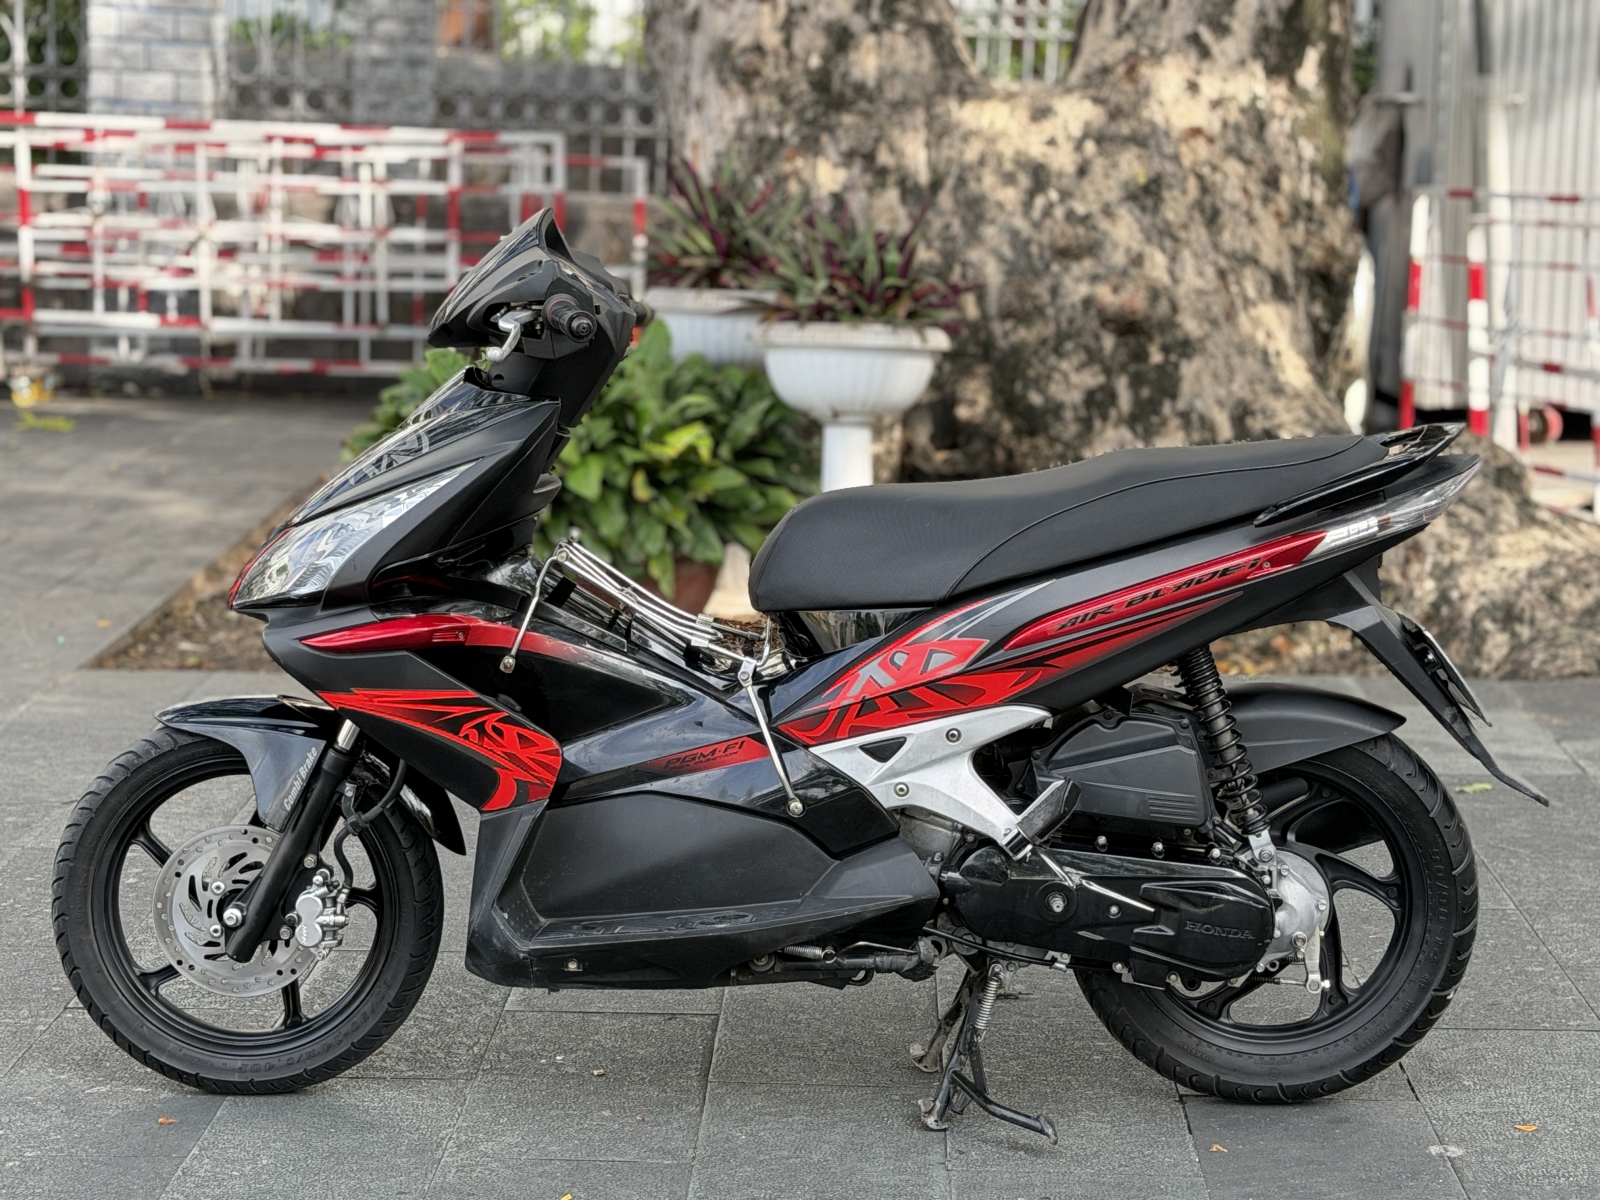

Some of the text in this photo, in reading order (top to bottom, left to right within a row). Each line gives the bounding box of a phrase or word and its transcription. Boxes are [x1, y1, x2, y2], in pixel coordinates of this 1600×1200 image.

[1056, 605, 1115, 631] AIR
[1124, 564, 1247, 607] BLADE
[283, 746, 318, 812] Combi Brake
[1184, 920, 1256, 940] HONDA
